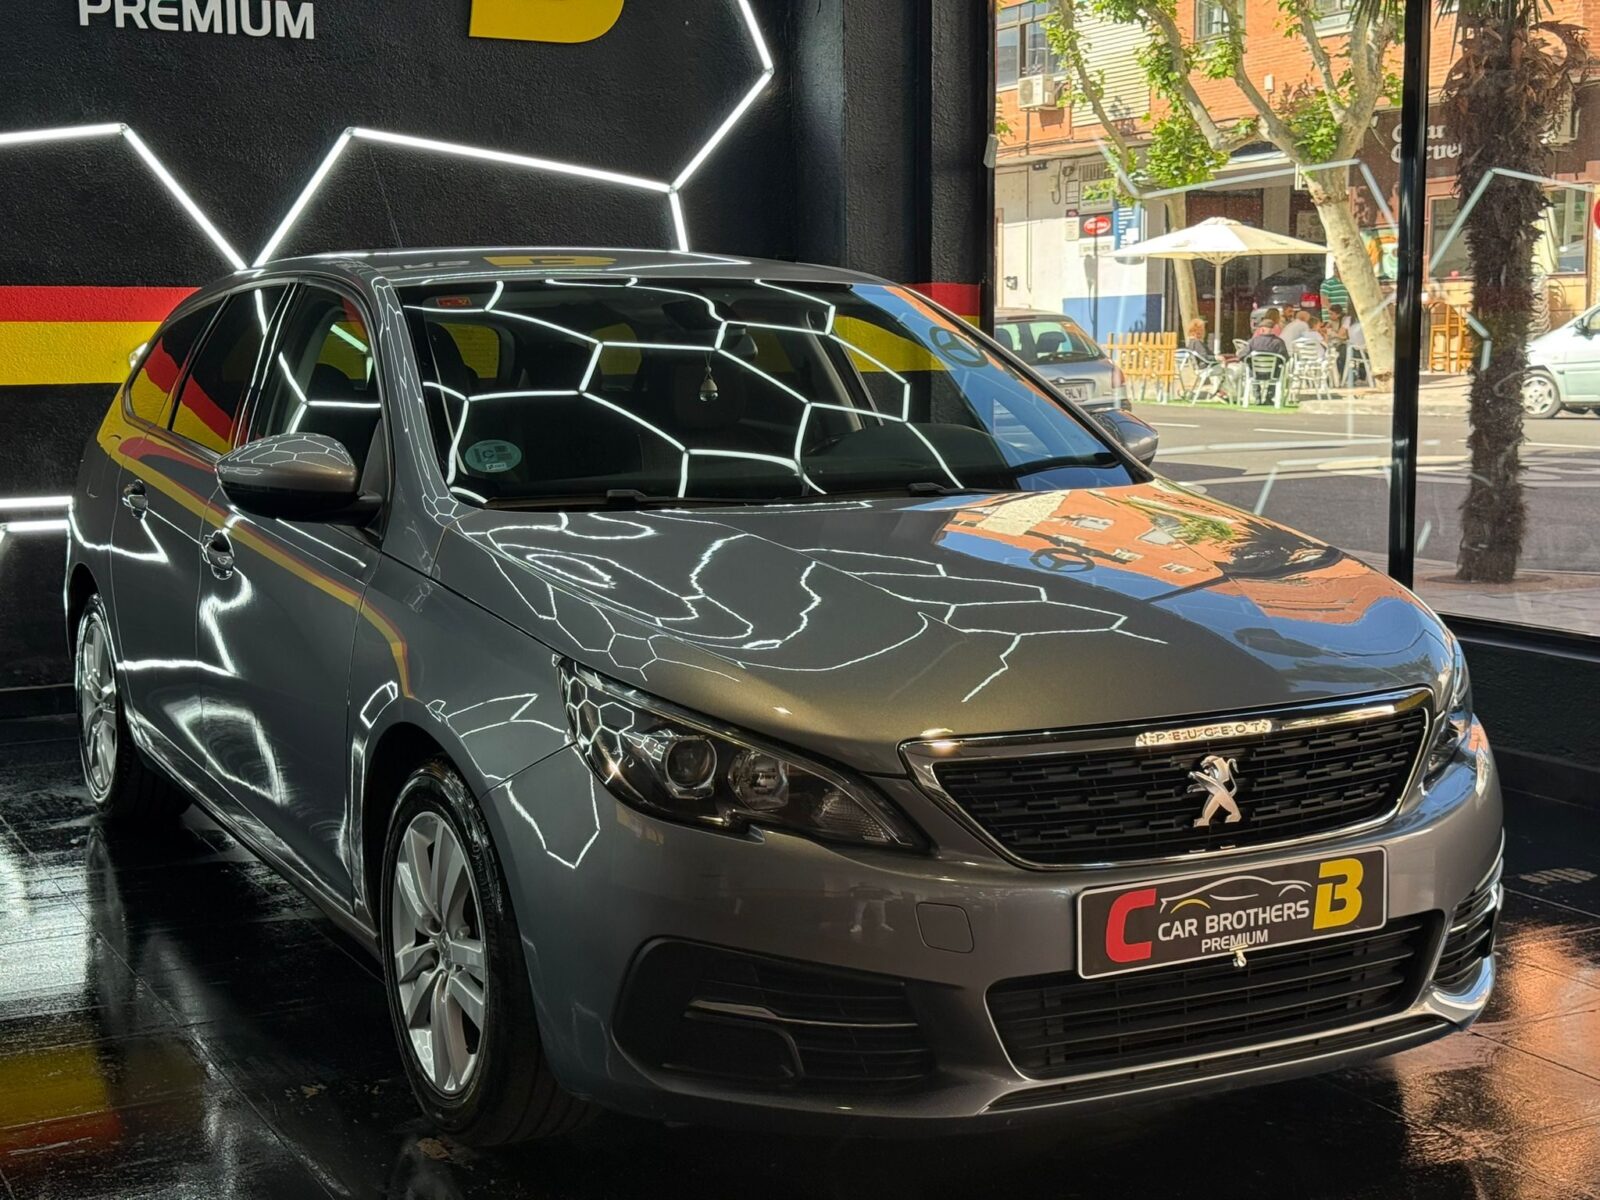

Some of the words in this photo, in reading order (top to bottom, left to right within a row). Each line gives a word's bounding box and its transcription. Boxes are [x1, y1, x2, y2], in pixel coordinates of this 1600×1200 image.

[78, 0, 315, 40] PREMIUM
[1155, 722, 1261, 741] PEUGEOT
[1312, 857, 1364, 930] B
[1105, 888, 1157, 963] C
[1157, 917, 1198, 942] CAR
[1205, 899, 1310, 935] BROTHERS
[1201, 928, 1269, 953] PREMIUM
